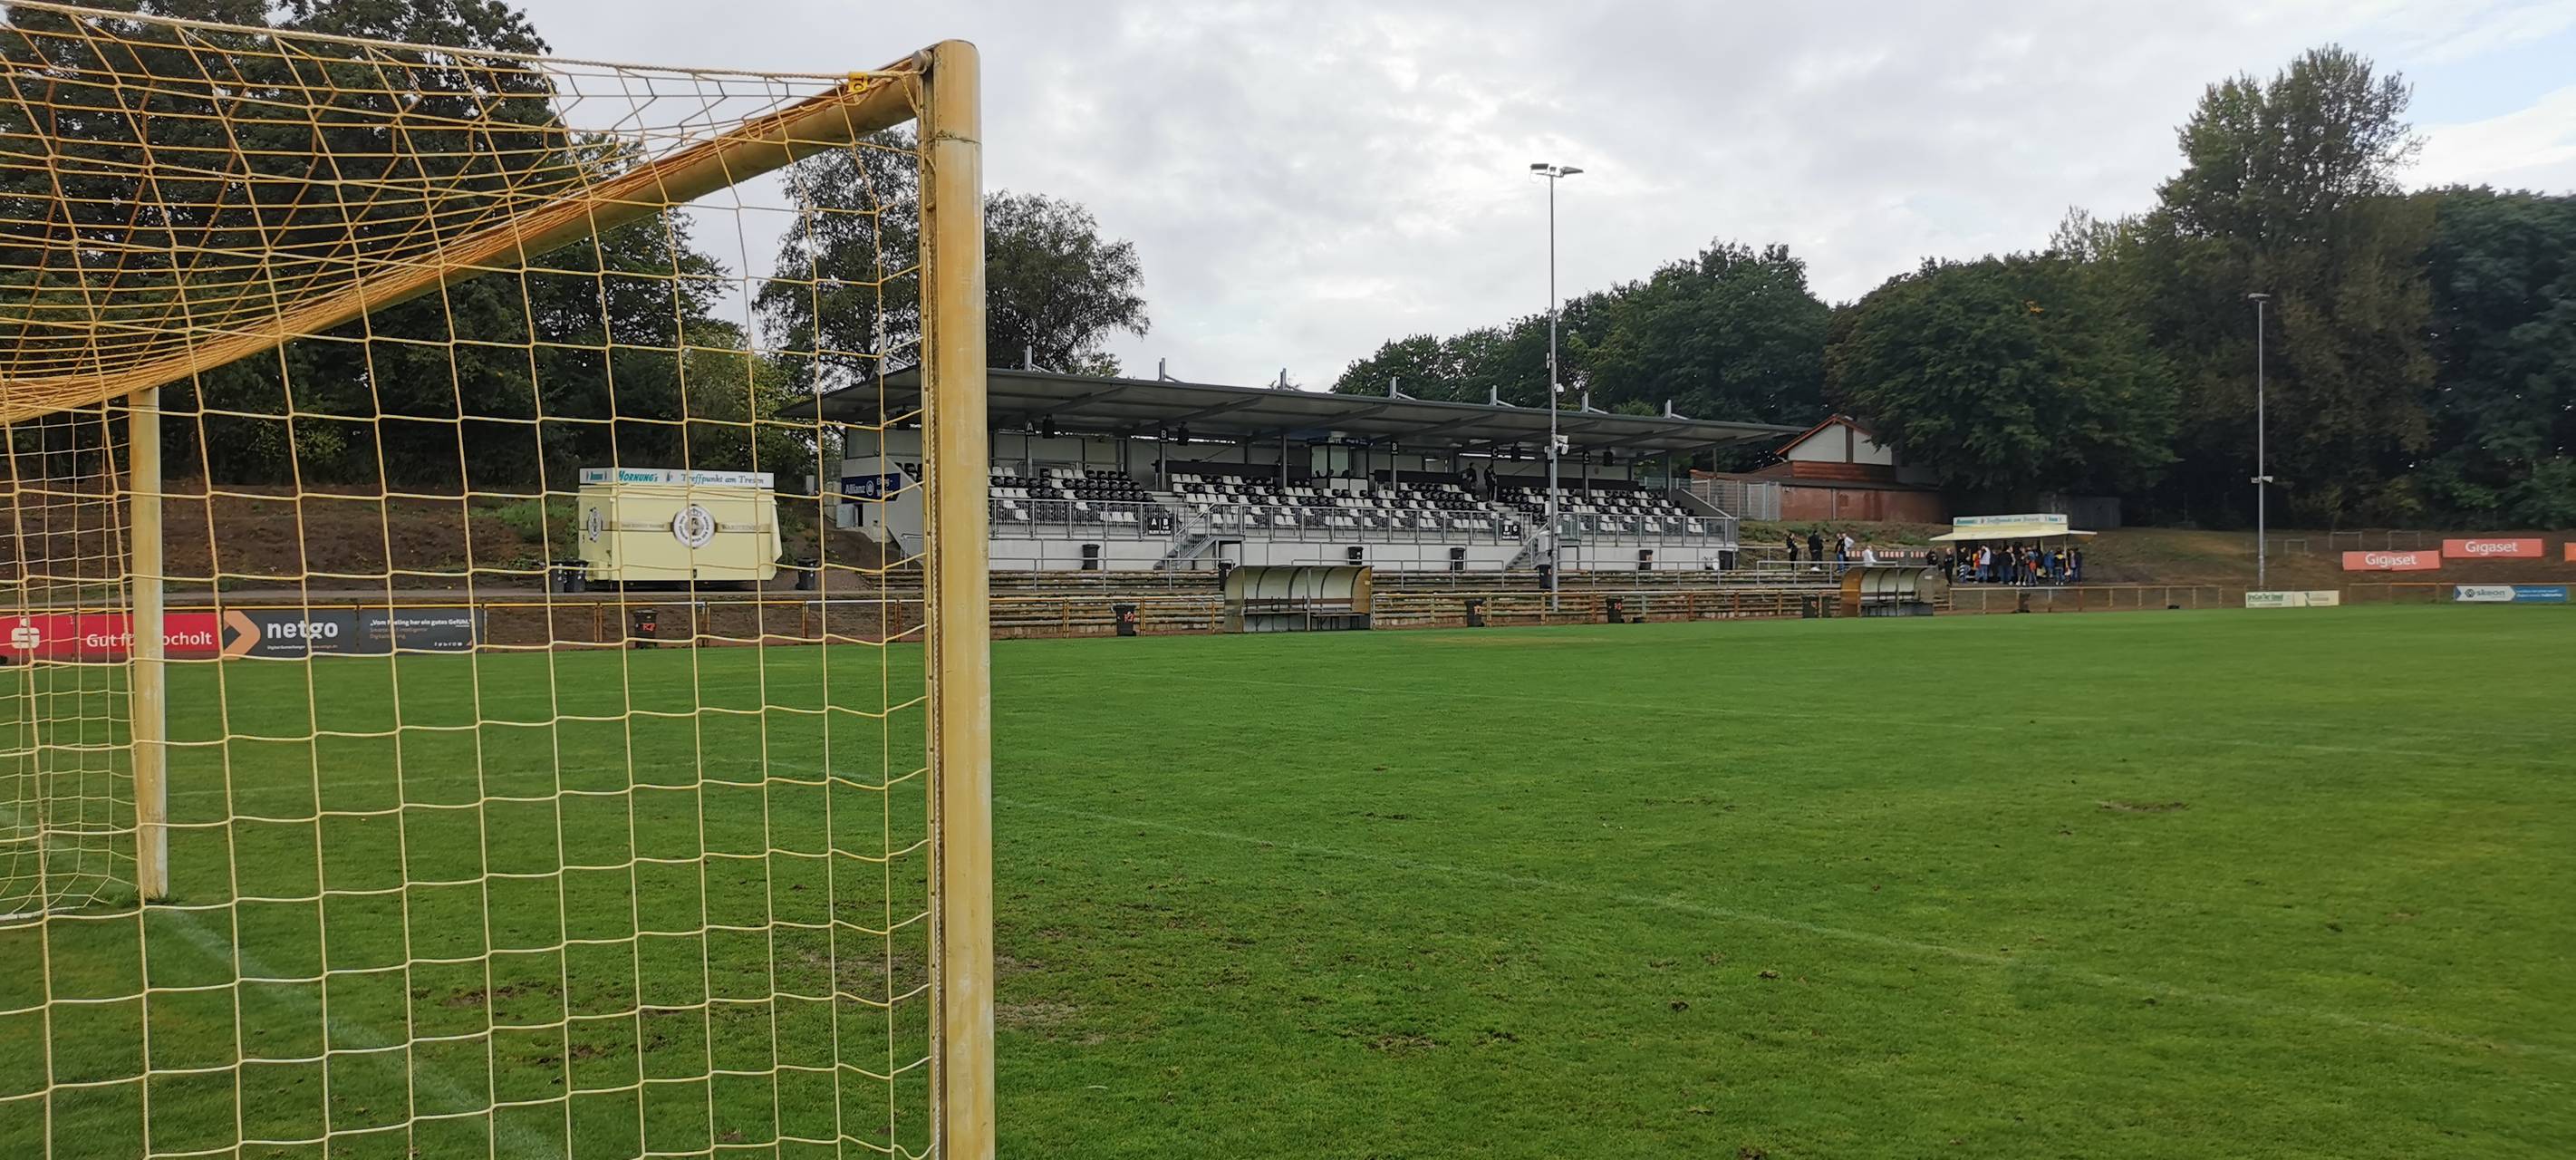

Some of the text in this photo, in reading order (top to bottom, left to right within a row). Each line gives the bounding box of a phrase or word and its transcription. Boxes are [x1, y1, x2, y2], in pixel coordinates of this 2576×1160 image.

[1027, 422, 1034, 431] A
[1161, 430, 1167, 439] B
[844, 483, 866, 495] Allianz
[1151, 517, 1157, 526] A
[2465, 541, 2518, 556] Gigaset
[2365, 554, 2417, 567] Gigaset
[266, 620, 339, 640] netgo
[86, 631, 213, 647] Gut fü ocholt
